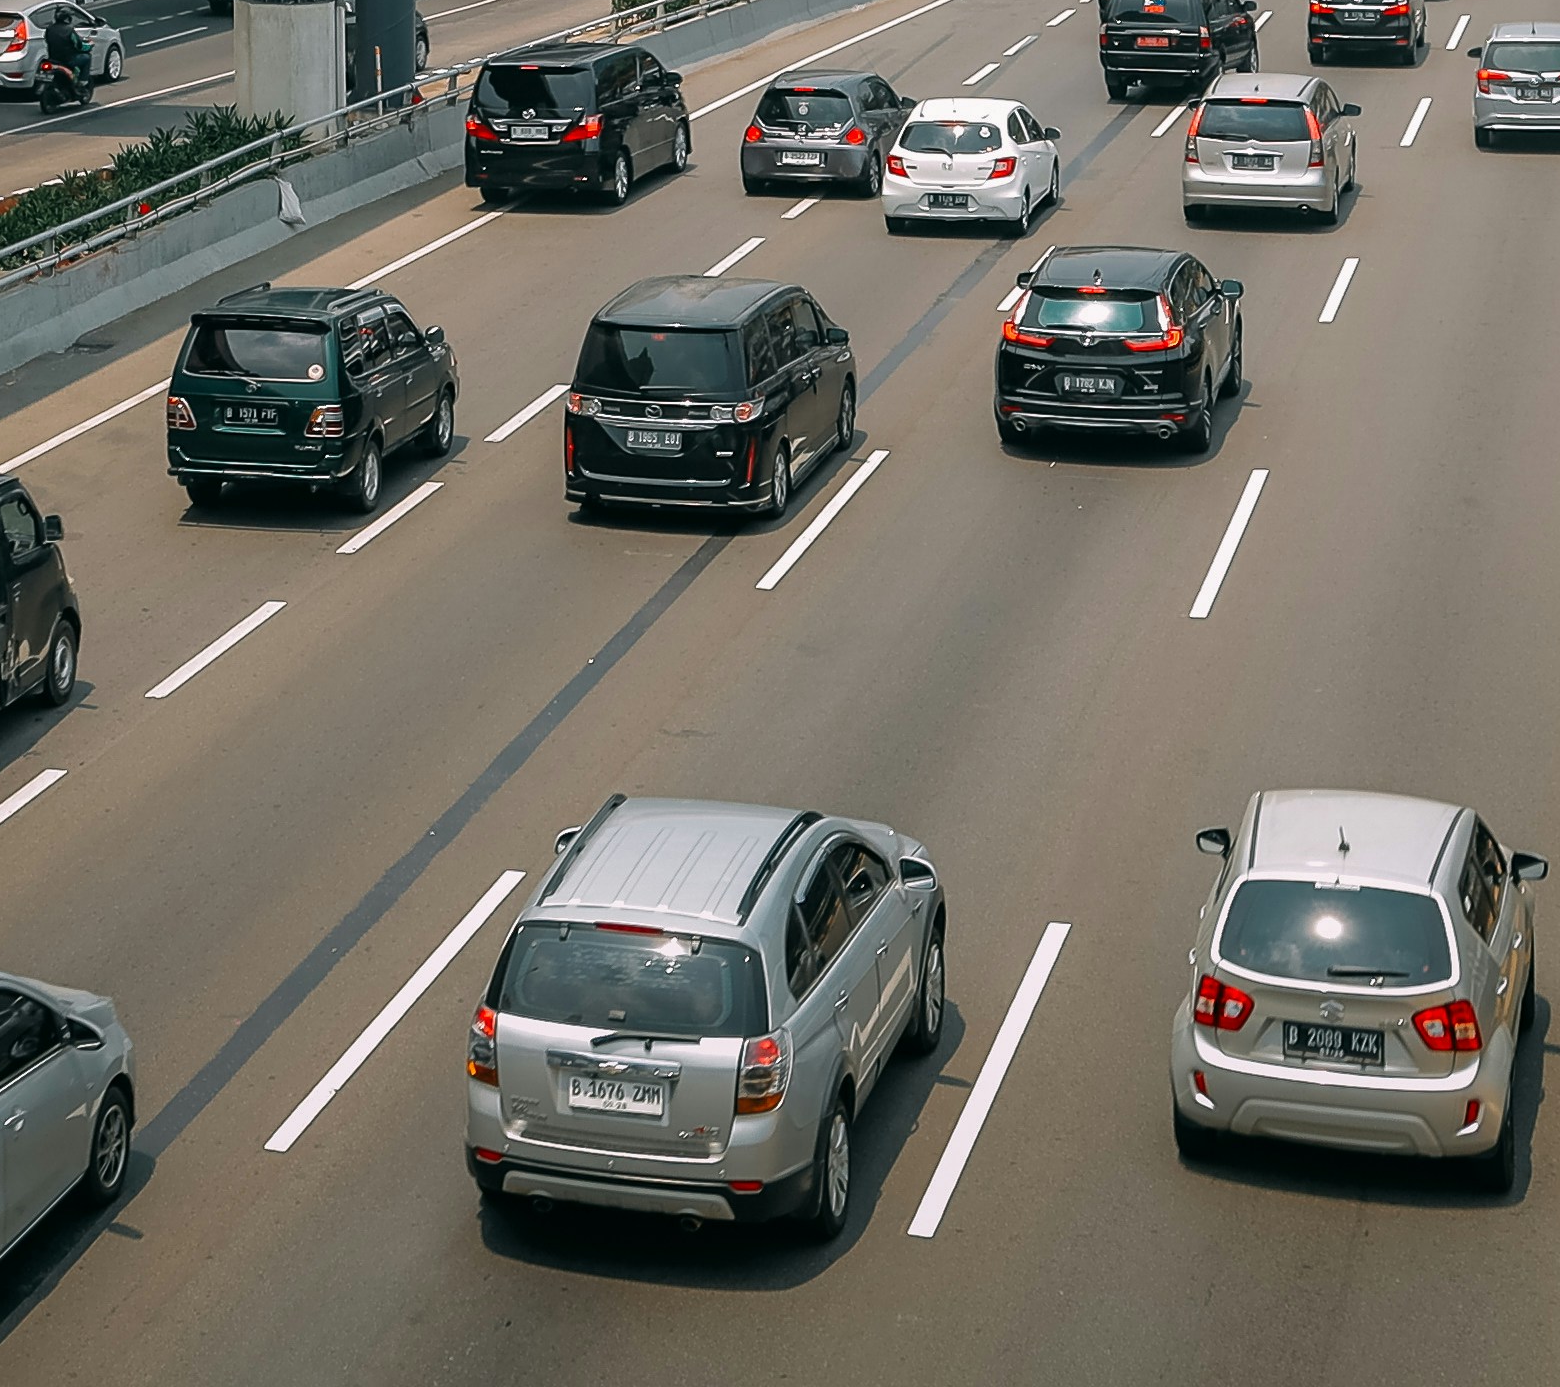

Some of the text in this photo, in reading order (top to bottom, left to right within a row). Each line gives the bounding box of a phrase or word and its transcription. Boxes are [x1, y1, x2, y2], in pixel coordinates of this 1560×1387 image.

[1288, 1025, 1299, 1046] B
[571, 1080, 582, 1096] B
[587, 1081, 625, 1101] 1676
[632, 1084, 662, 1106] ZMM
